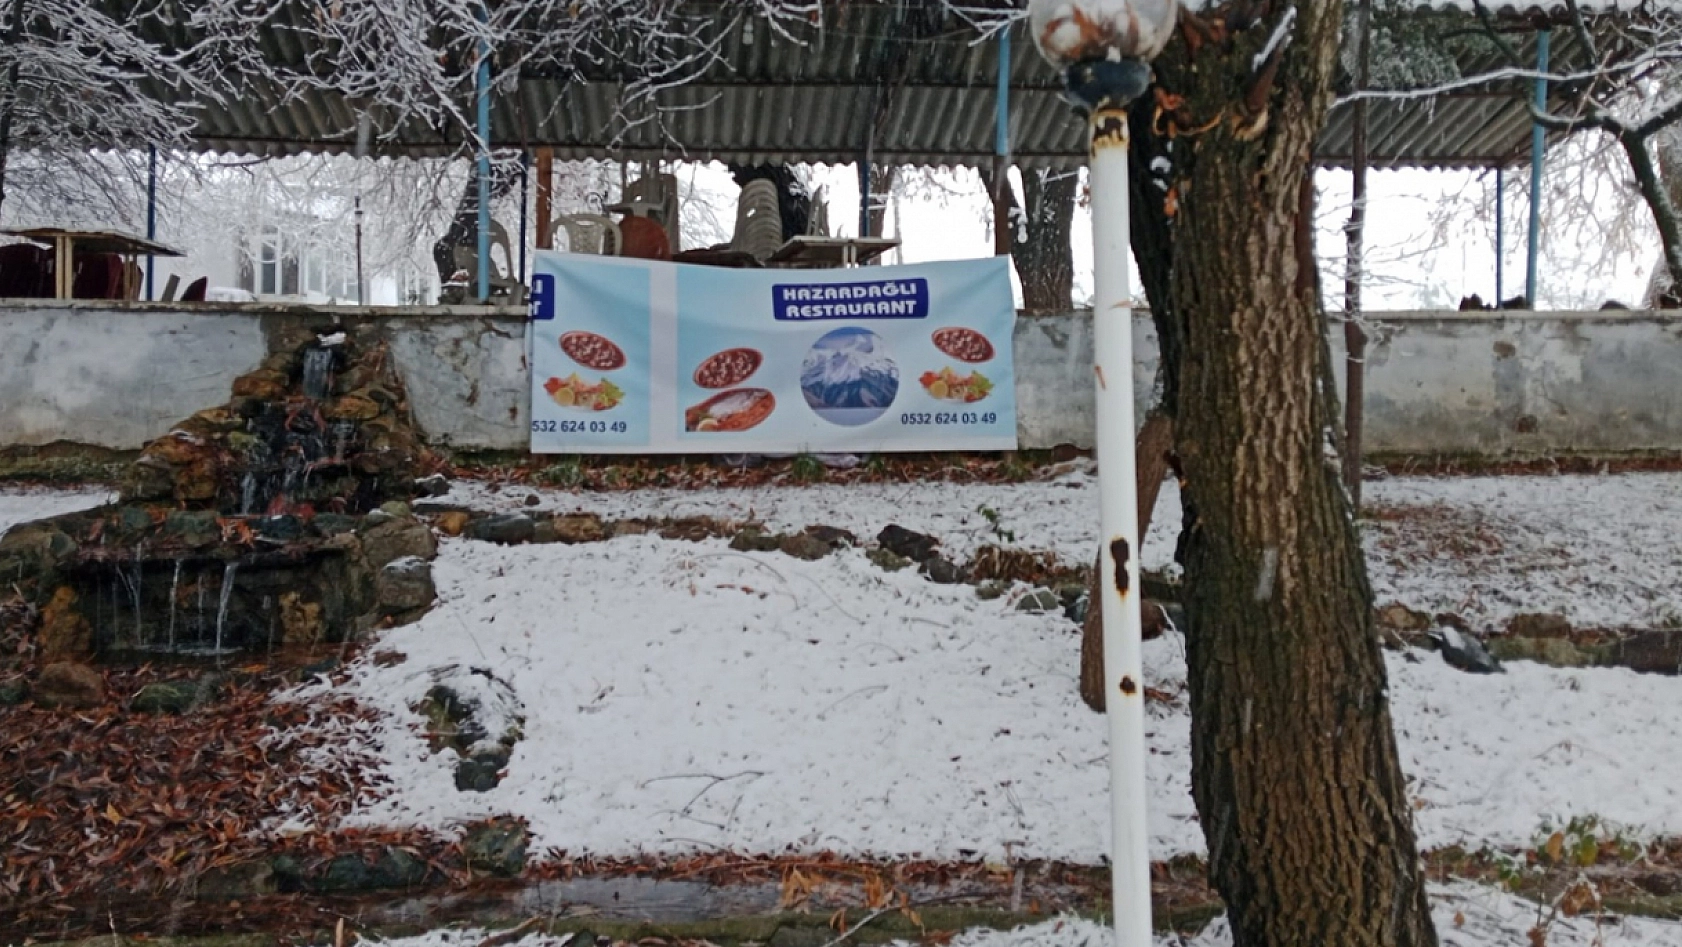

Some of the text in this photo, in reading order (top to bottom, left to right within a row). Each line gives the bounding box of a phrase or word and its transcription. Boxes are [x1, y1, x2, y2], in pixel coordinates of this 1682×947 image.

[783, 281, 917, 301] HAZARDAĞLI
[785, 300, 917, 318] RESTAURANT
[560, 420, 586, 432] 624
[589, 420, 606, 432] 03
[610, 420, 627, 432] 49
[901, 411, 997, 425] 0532 624 03 49
